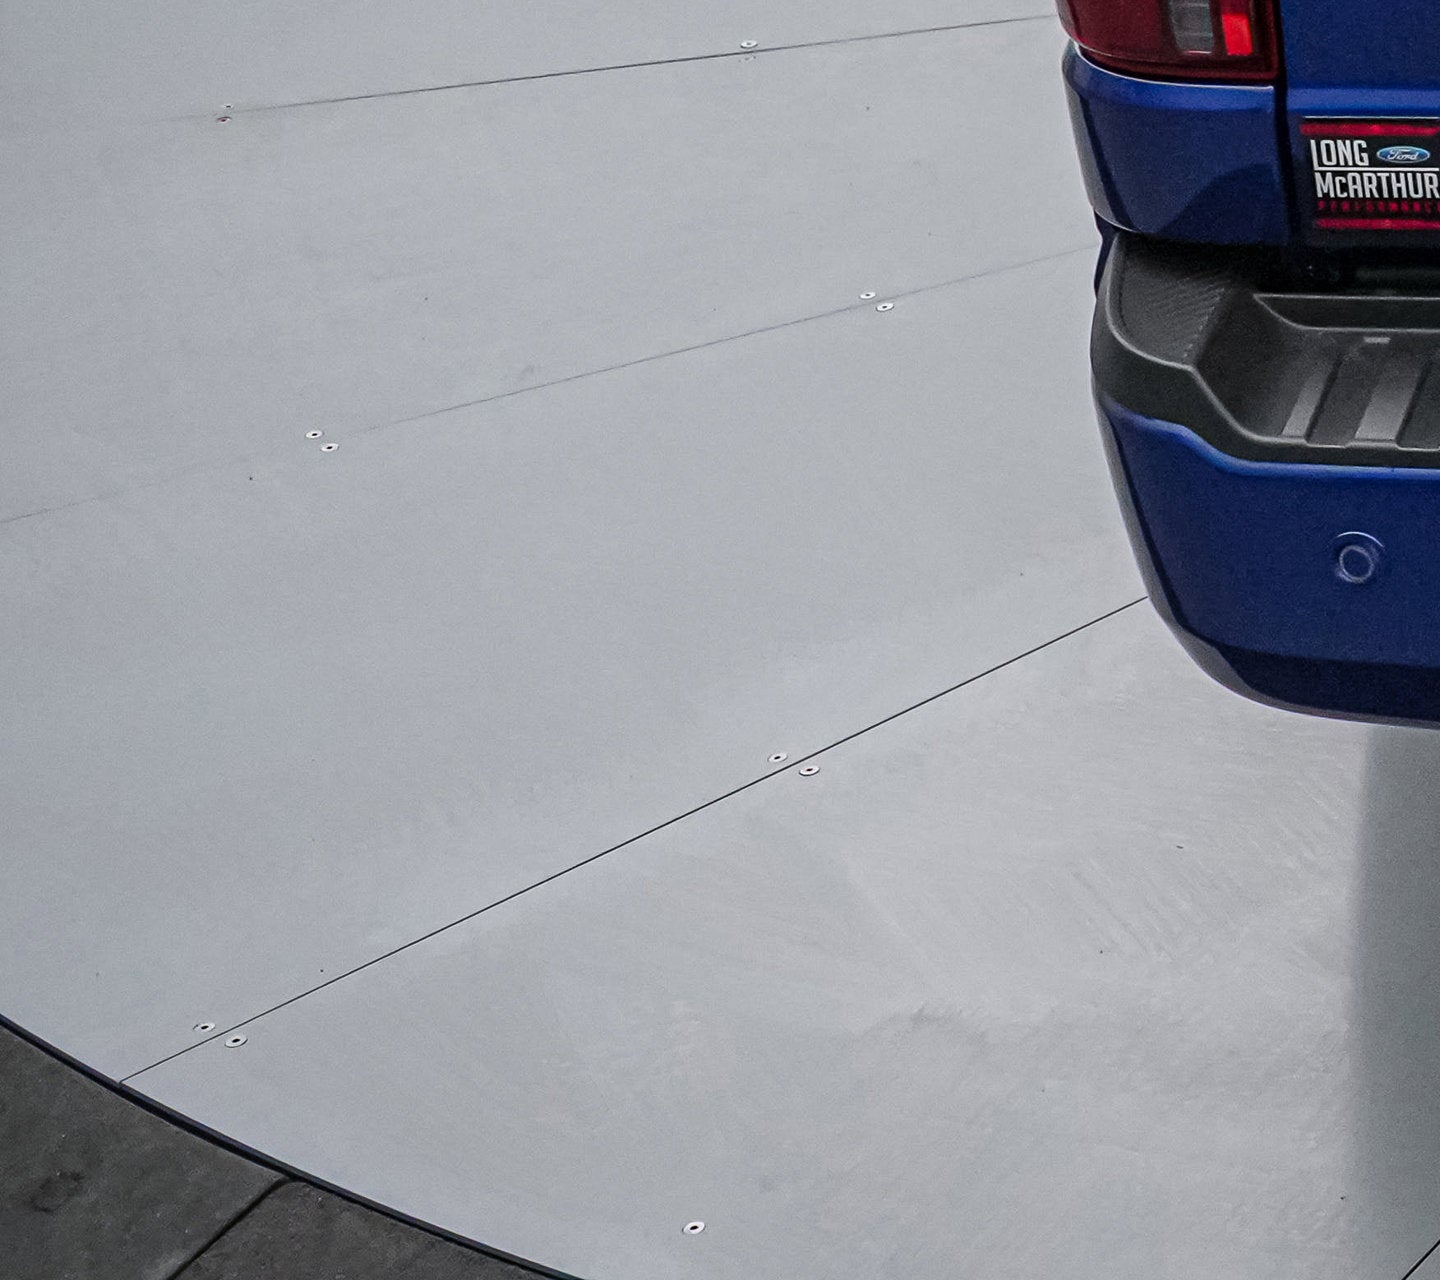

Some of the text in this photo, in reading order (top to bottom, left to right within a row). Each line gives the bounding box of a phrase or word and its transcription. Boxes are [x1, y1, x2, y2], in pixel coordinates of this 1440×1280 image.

[1309, 139, 1370, 171] LONG
[1387, 148, 1420, 161] Ford
[1314, 172, 1440, 199] McARTHUR
